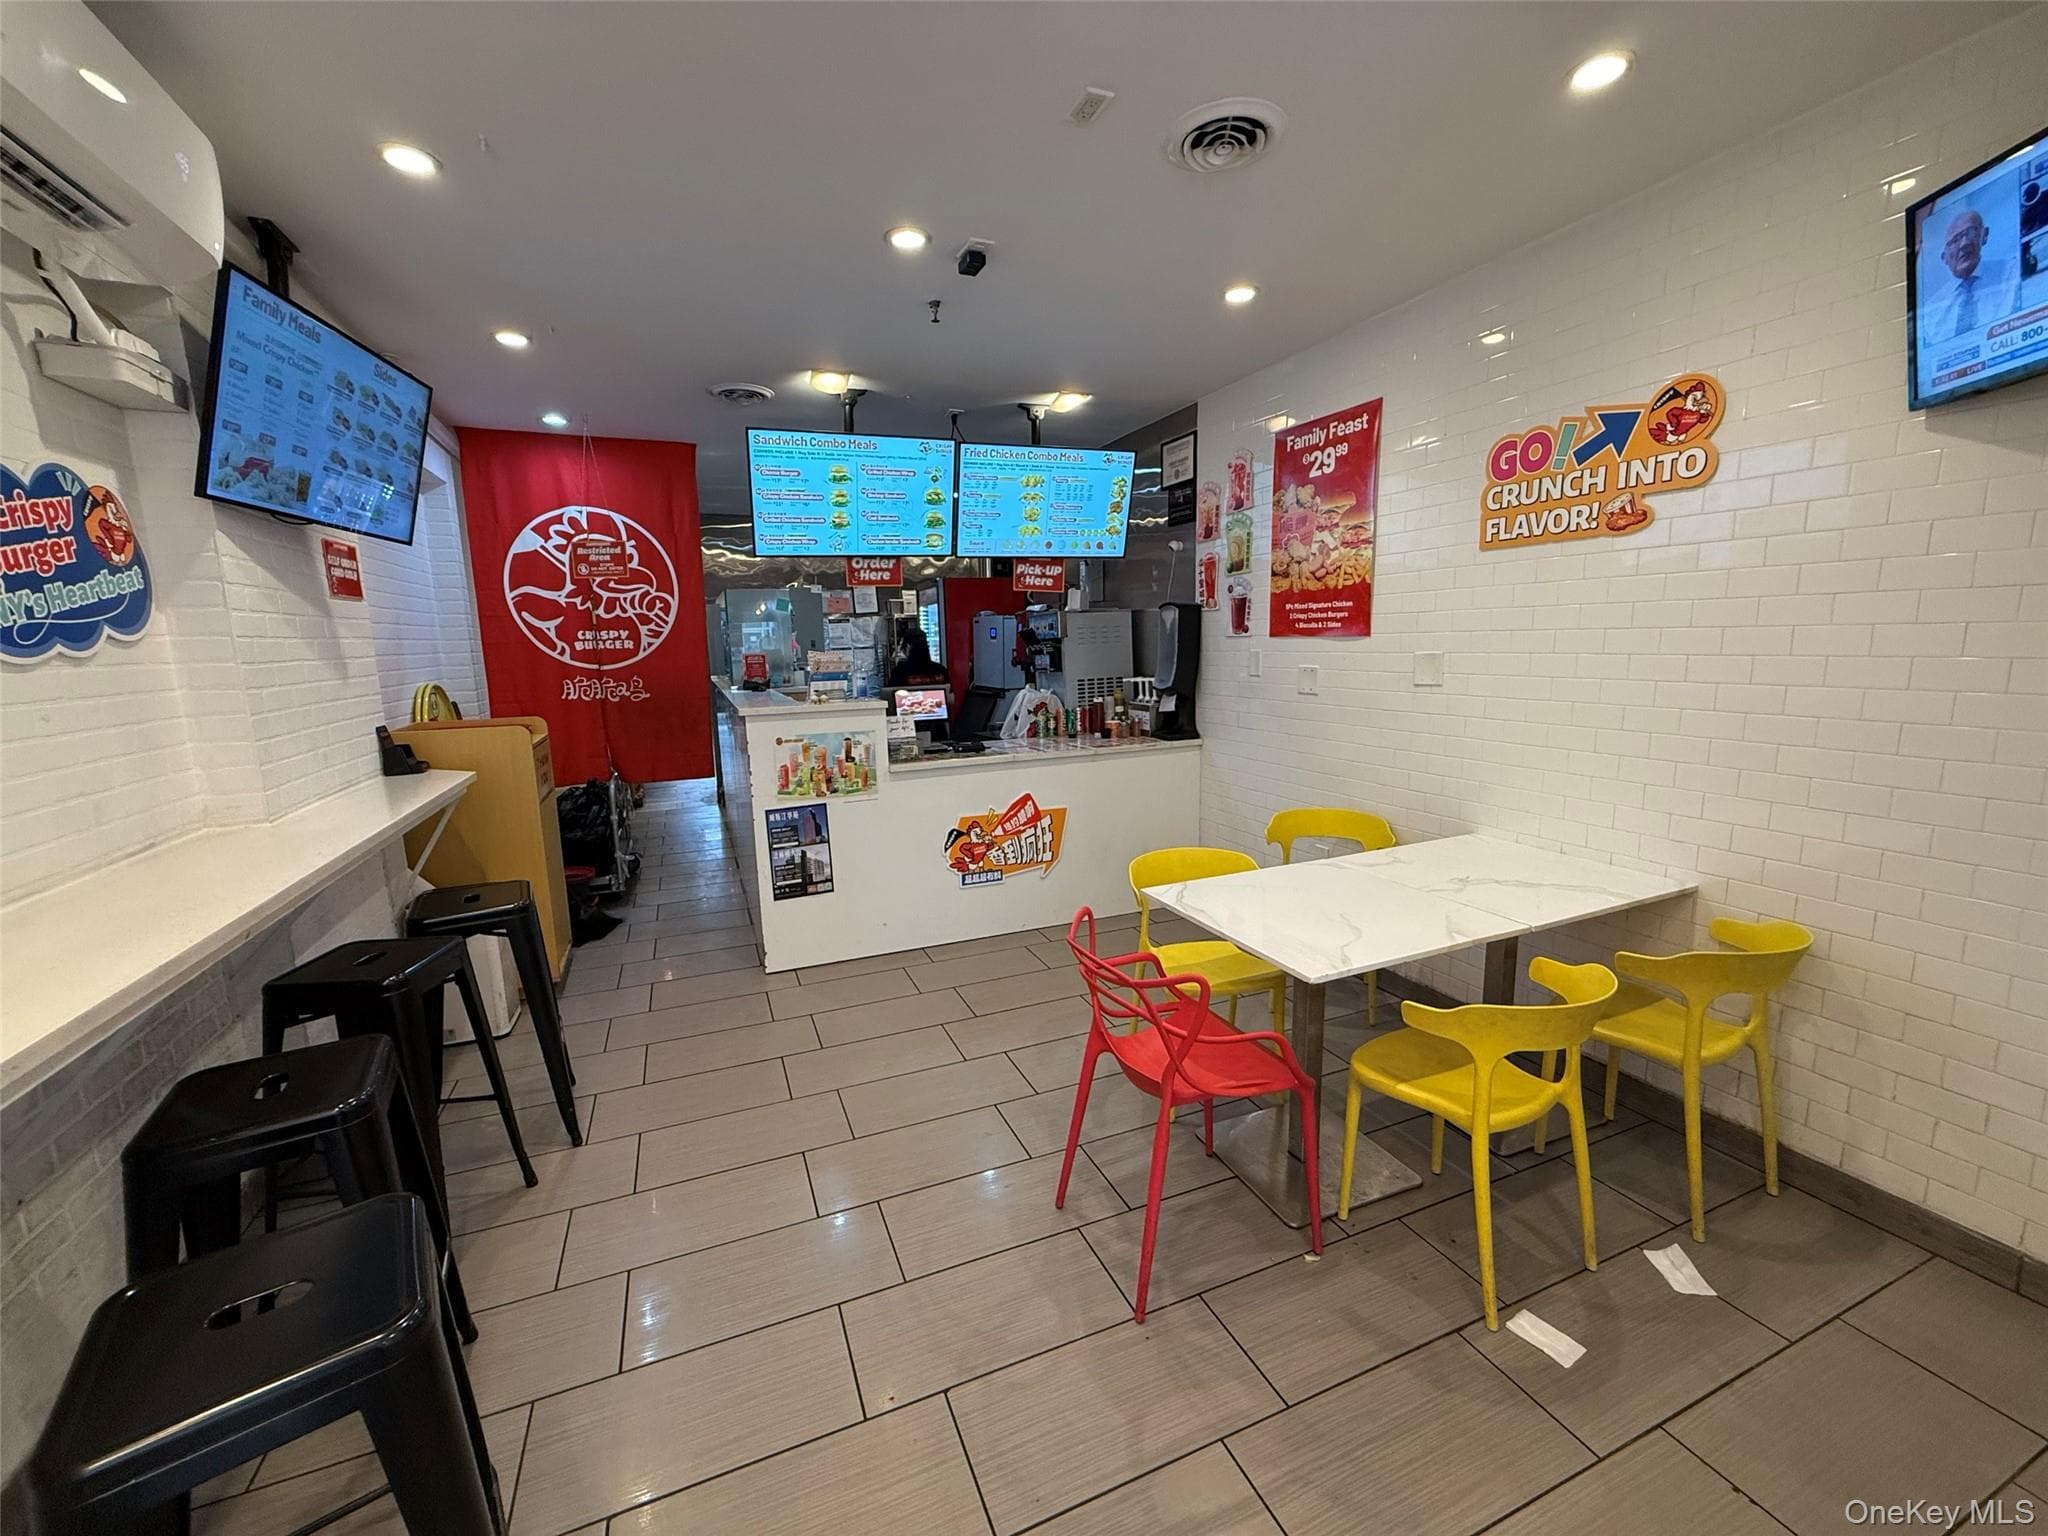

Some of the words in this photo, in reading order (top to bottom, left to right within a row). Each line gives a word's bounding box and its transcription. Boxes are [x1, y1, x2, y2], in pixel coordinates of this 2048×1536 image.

[243, 285, 287, 326] Family
[288, 312, 322, 343] Meals
[1990, 335, 2019, 353] CALL:
[2021, 325, 2048, 342] 800-
[263, 344, 286, 364] Crispy
[373, 362, 398, 388] Sides
[753, 433, 807, 447] Sandwich
[809, 437, 846, 448] Combo
[848, 439, 878, 450] Meals
[1286, 427, 1327, 452] Family
[1329, 412, 1369, 439] Feast
[964, 447, 988, 458] Fried
[989, 448, 1026, 459] Chicken
[1027, 450, 1058, 461] Combo
[1059, 452, 1084, 462] Meals
[1490, 422, 1581, 482] GO!
[1486, 465, 1607, 511] CRUNCH
[1616, 447, 1707, 490] INTO
[1485, 501, 1600, 543] FLAVOR!
[0, 536, 76, 577] urger
[576, 545, 622, 555] Restricted
[851, 557, 897, 569] Order
[1016, 563, 1063, 576] Pick-UP
[859, 569, 892, 580] Here
[1024, 573, 1054, 587] Here
[43, 565, 144, 614] Heartbeat
[577, 629, 630, 640] CRISPY
[574, 640, 634, 651] BURGER
